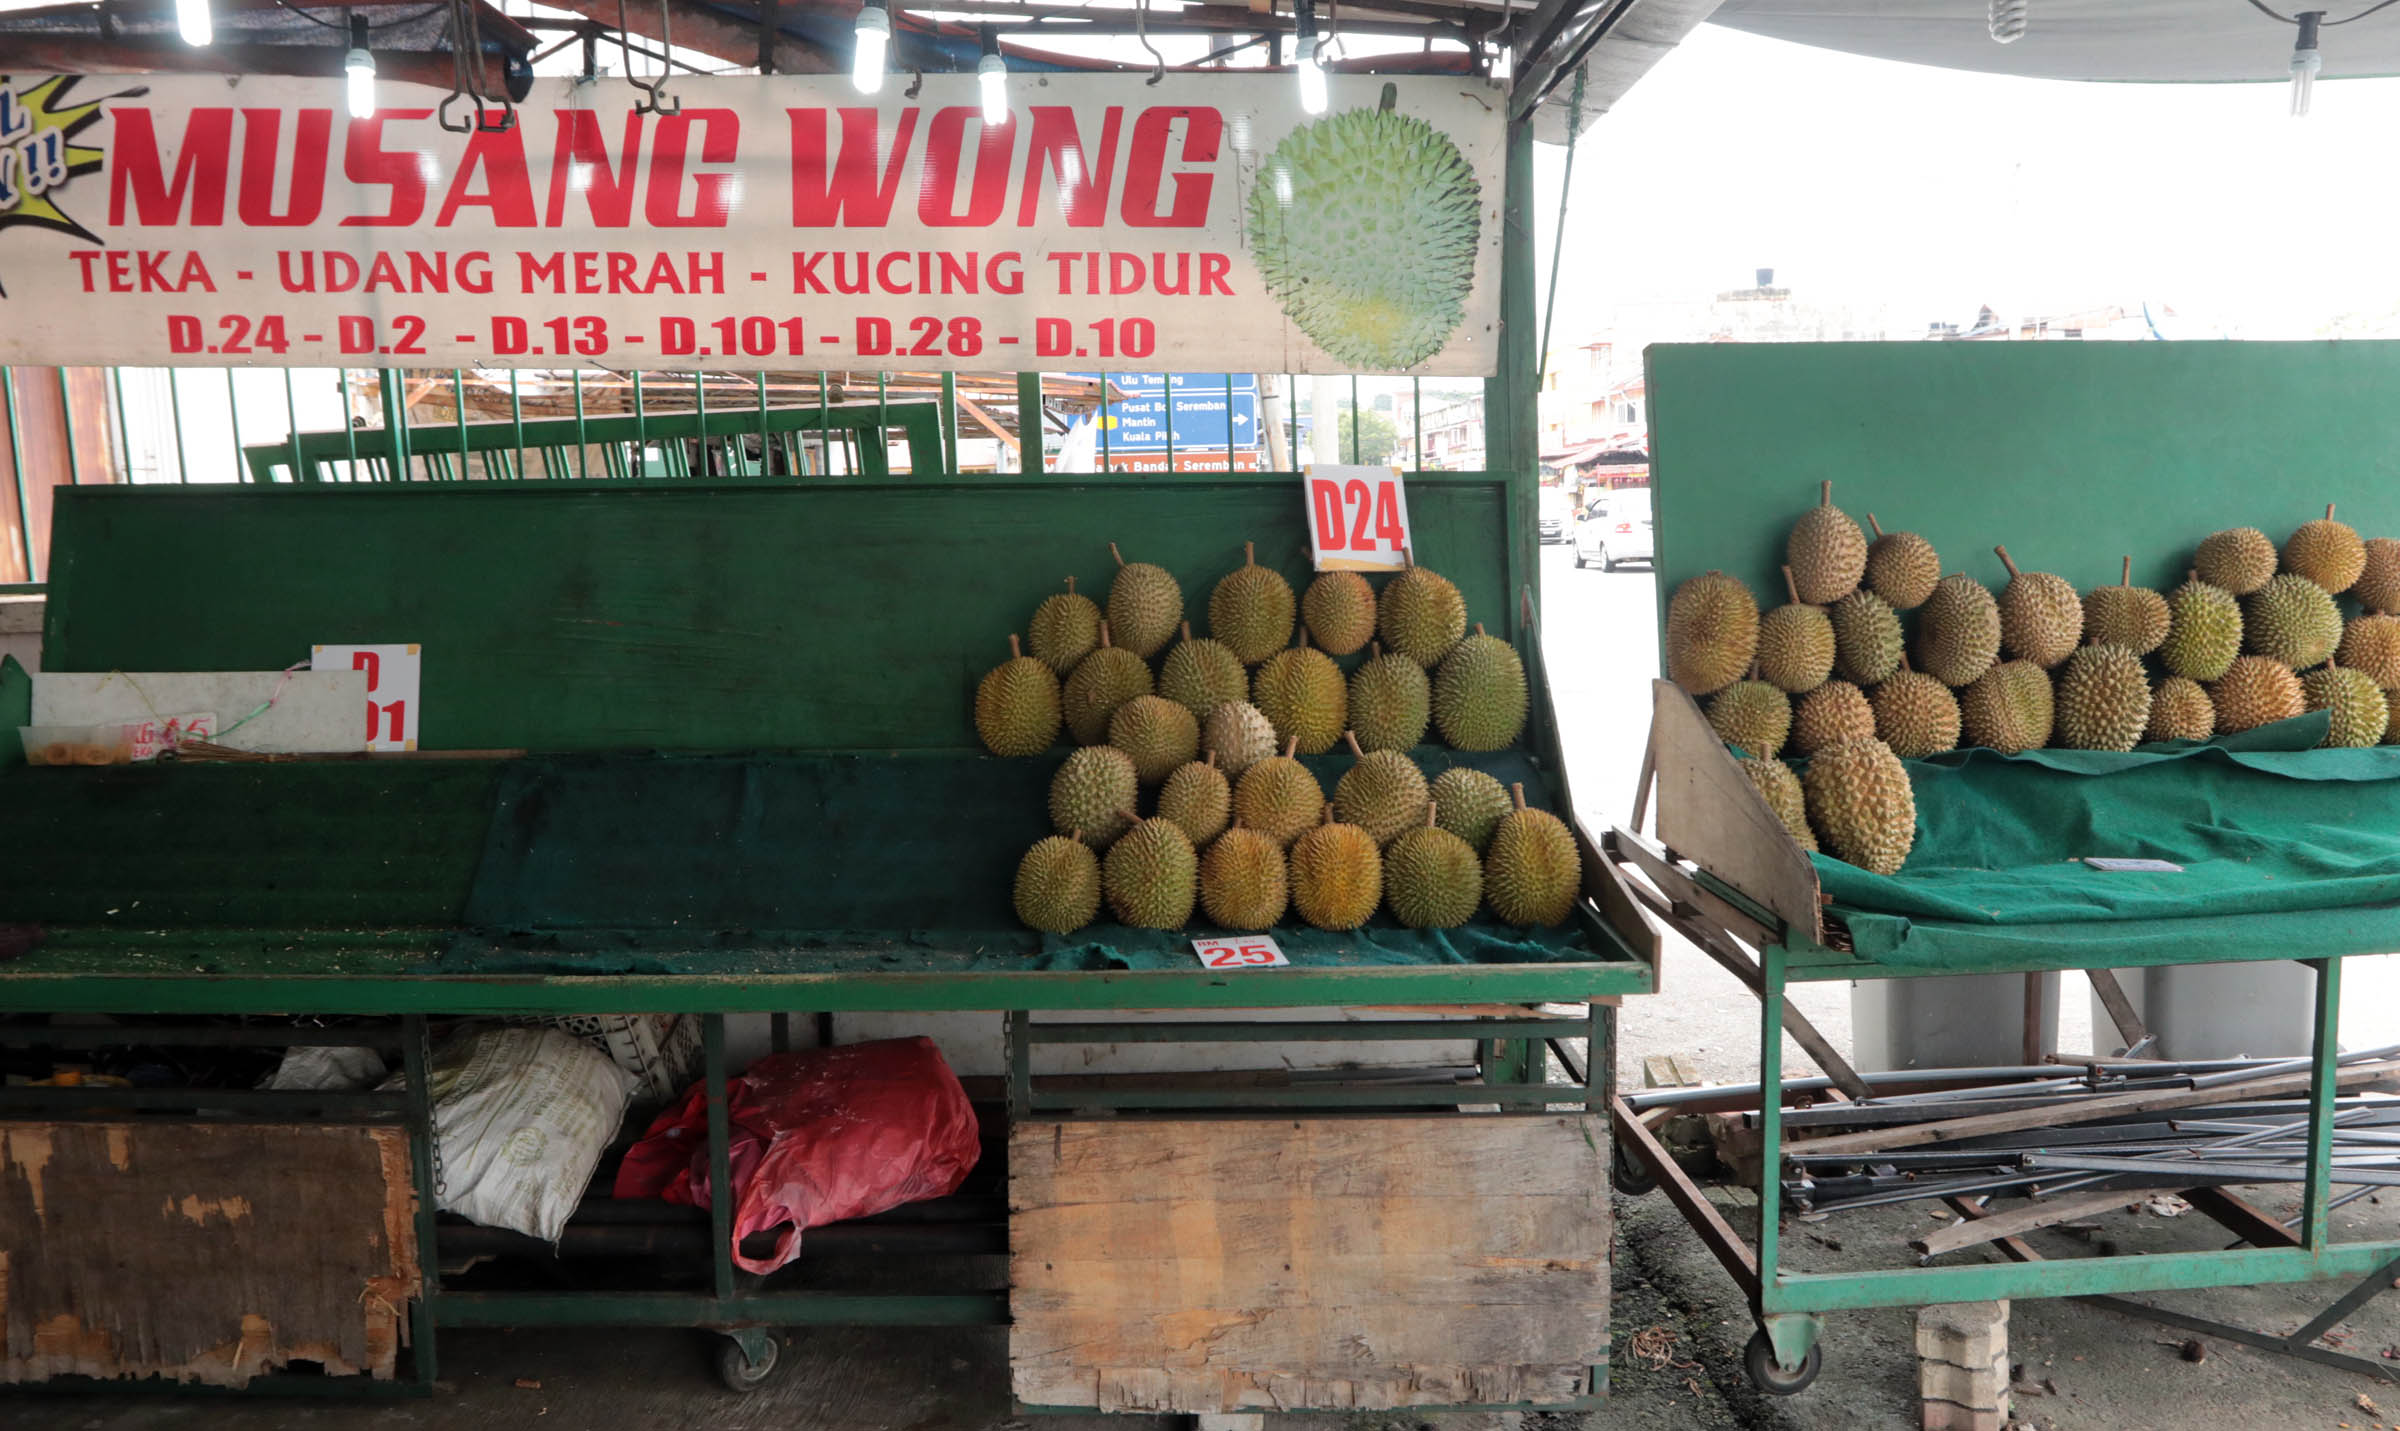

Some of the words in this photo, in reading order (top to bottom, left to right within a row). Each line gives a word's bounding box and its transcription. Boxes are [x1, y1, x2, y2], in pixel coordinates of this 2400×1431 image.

[108, 107, 740, 227] MUSANG
[786, 106, 1222, 227] WONG
[69, 250, 217, 293] TEKA
[278, 251, 494, 294] UDANG
[517, 251, 725, 294] MERAH
[792, 251, 1024, 295] KUCING
[1048, 252, 1236, 296] TIDUR
[167, 314, 290, 354] D.24
[338, 315, 426, 354] D.2
[491, 316, 608, 355] D.13
[659, 316, 804, 356] D.101
[856, 317, 983, 357] D.28
[1036, 317, 1156, 358] D.10
[1121, 375, 1138, 385] Ulu
[1121, 403, 1150, 412] Pusat
[1176, 401, 1226, 411] Seremban
[1122, 417, 1156, 427] Mantin
[1122, 432, 1151, 441] Kuala
[1312, 479, 1404, 551] D24
[1203, 944, 1276, 966] 25
